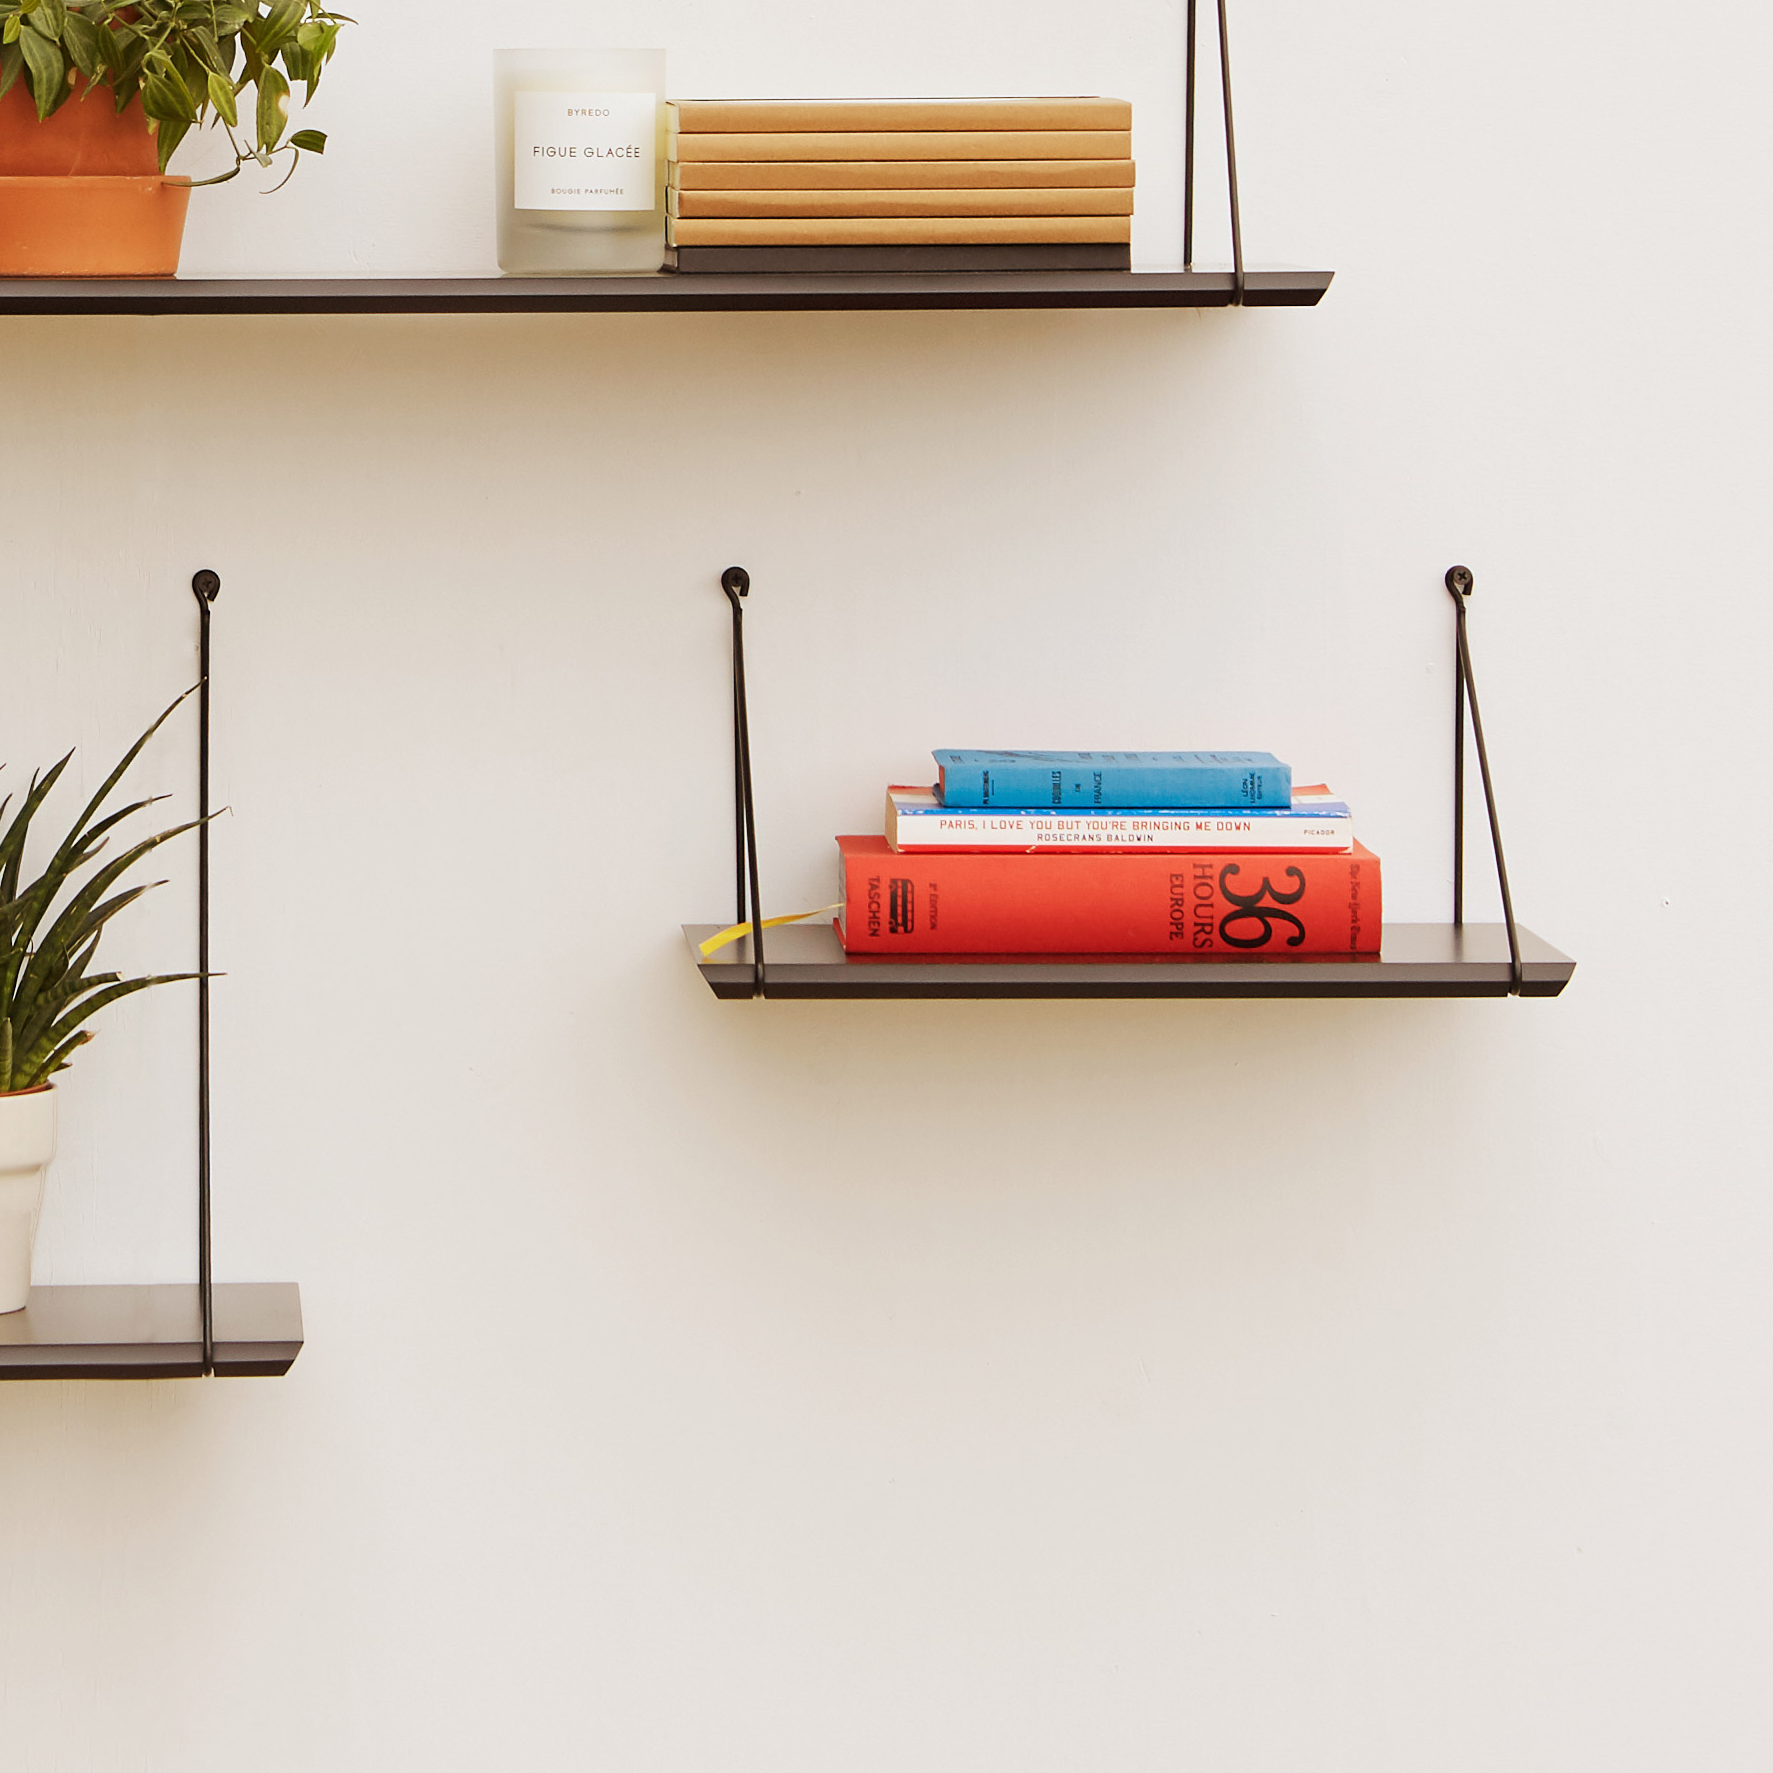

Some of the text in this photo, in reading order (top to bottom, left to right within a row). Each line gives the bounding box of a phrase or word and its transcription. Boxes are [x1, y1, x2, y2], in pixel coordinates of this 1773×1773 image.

[567, 108, 610, 116] BYREDO
[533, 144, 640, 158] FIGUE GLACÉE
[584, 187, 624, 195] PARFUMÉE
[1094, 771, 1102, 804] FRANCE
[940, 820, 978, 831] PARIS,
[990, 820, 1023, 830] LOVE
[1030, 820, 1052, 830] YOU
[1058, 820, 1082, 830] BUT
[1086, 820, 1127, 830] YOU'RE
[1132, 820, 1190, 830] BRINGING
[1196, 821, 1212, 831] ME
[1216, 821, 1251, 831] DOWN
[1036, 834, 1154, 842] ROSECRANS BALDWIN
[868, 876, 880, 937] TASCHEN
[1170, 873, 1184, 940] EUROPE
[1192, 863, 1214, 948] HOURS
[1219, 864, 1306, 948] 36
